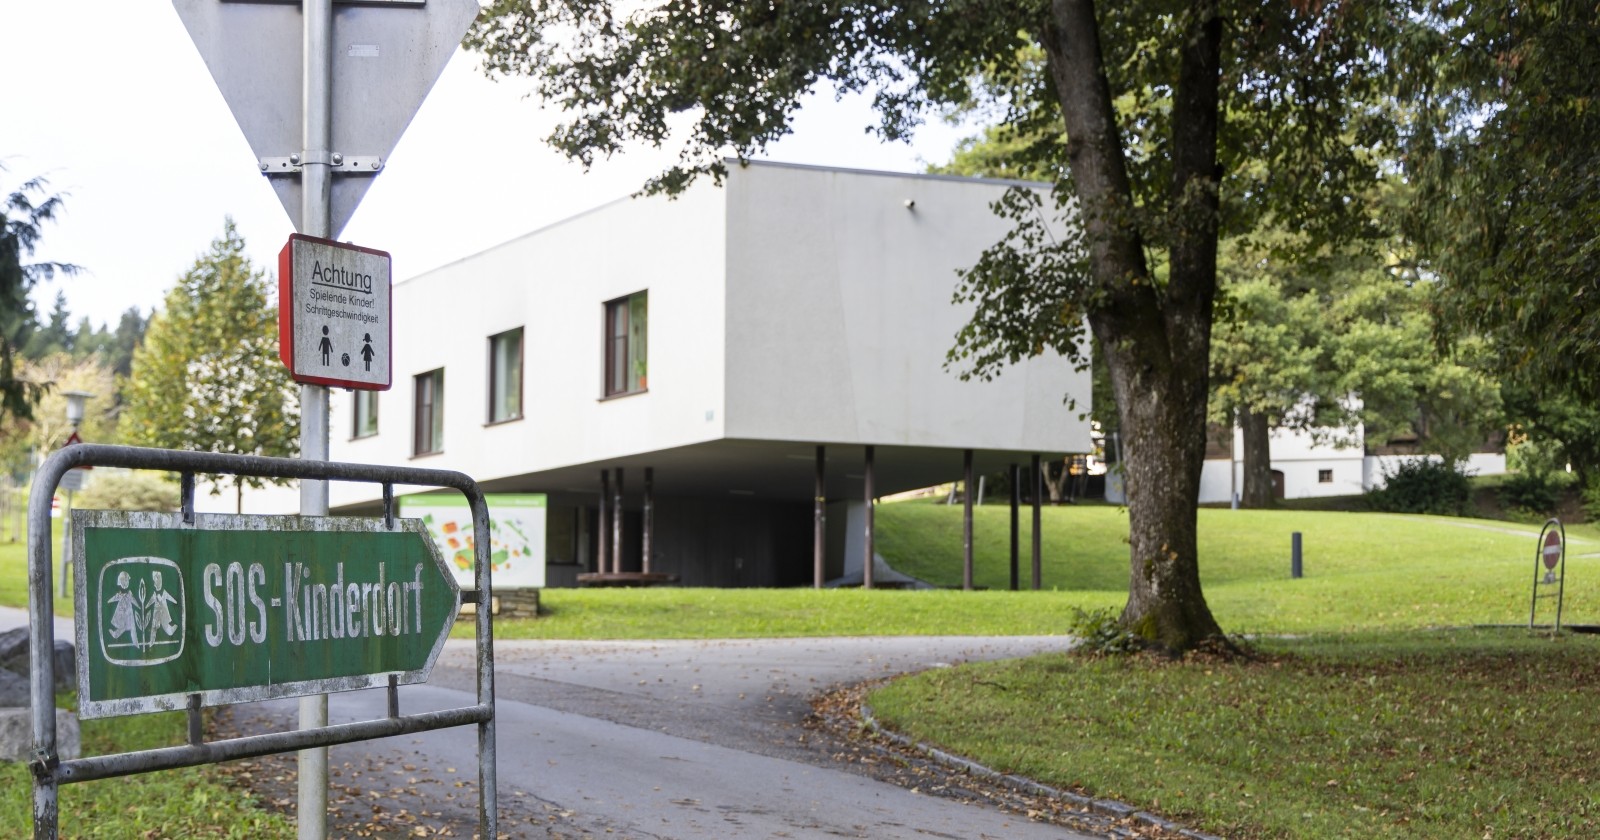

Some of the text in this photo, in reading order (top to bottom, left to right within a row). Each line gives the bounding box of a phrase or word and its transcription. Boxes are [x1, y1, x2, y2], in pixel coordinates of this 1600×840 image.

[312, 260, 372, 294] Achtung
[310, 288, 375, 309] Spielende Kinder!
[305, 303, 379, 325] Schrittgeschwindigkeit
[203, 561, 424, 647] SOS-Kinderdorf
